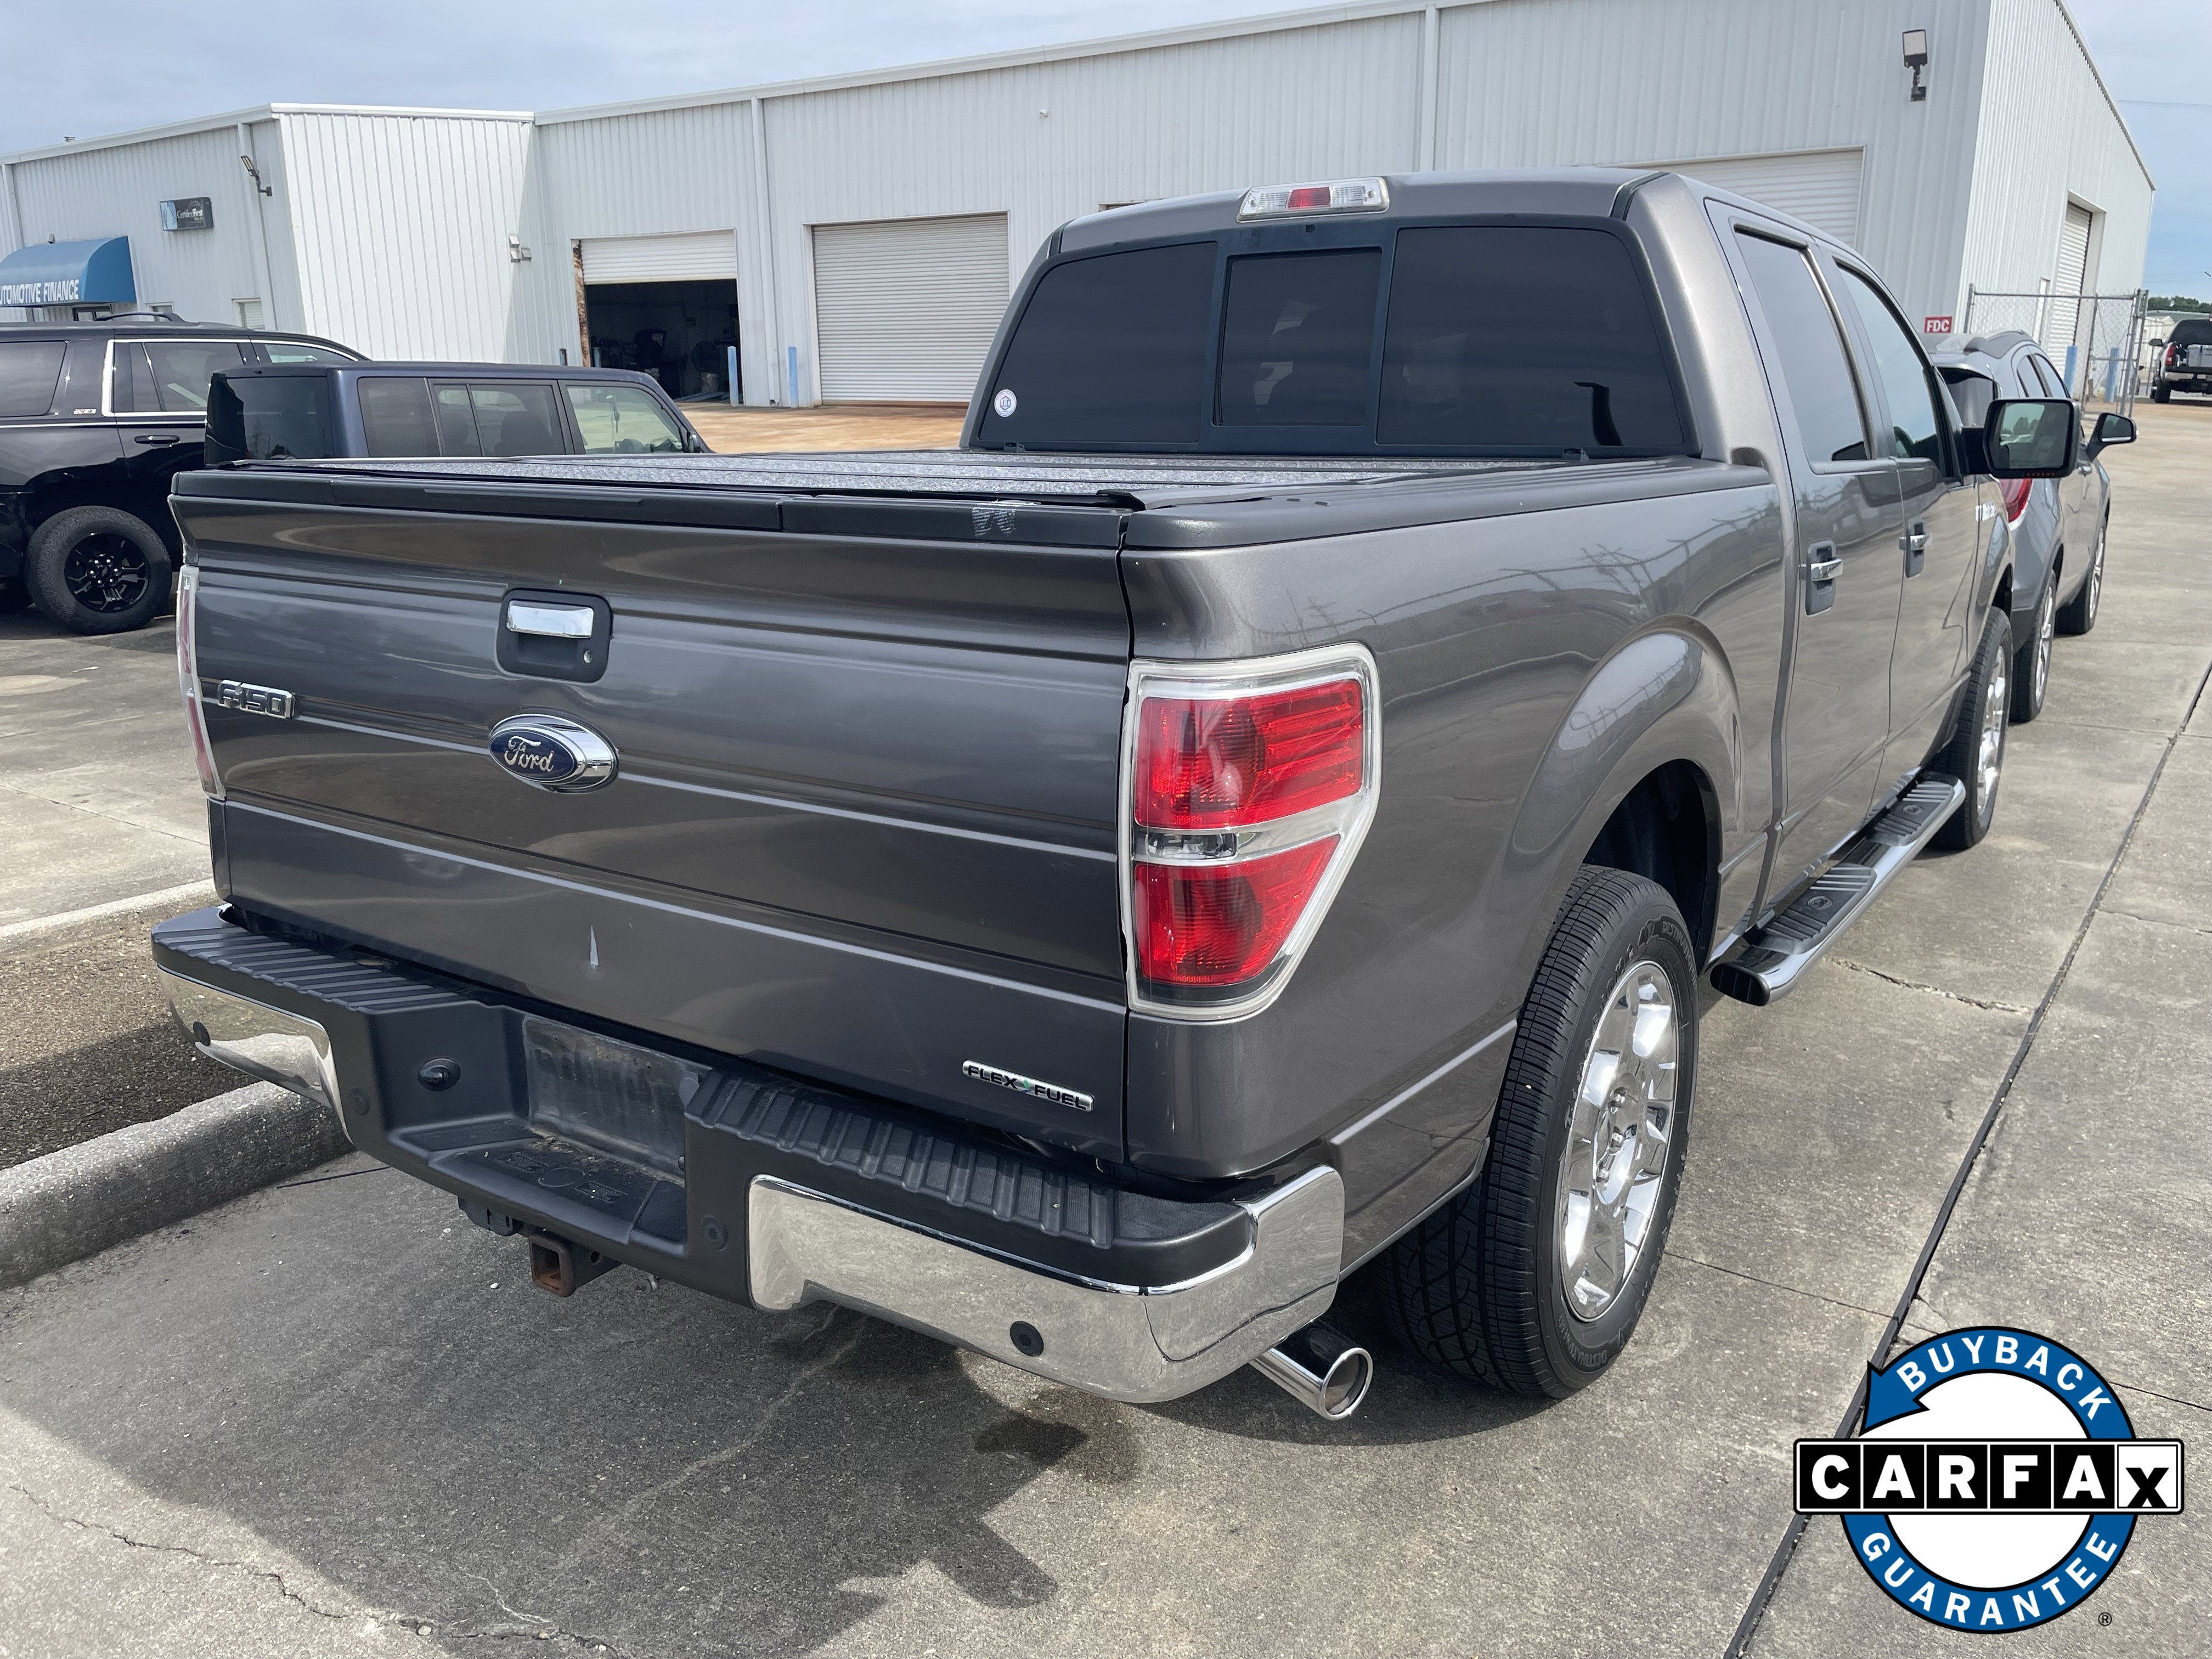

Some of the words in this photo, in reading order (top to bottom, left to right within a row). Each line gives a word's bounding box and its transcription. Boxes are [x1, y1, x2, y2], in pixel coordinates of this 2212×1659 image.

[43, 279, 79, 302] FINANCE
[1926, 319, 1950, 332] FDC
[504, 736, 554, 772] Ford
[968, 1065, 1017, 1089] FLEX
[1034, 1084, 1086, 1110] FUEL
